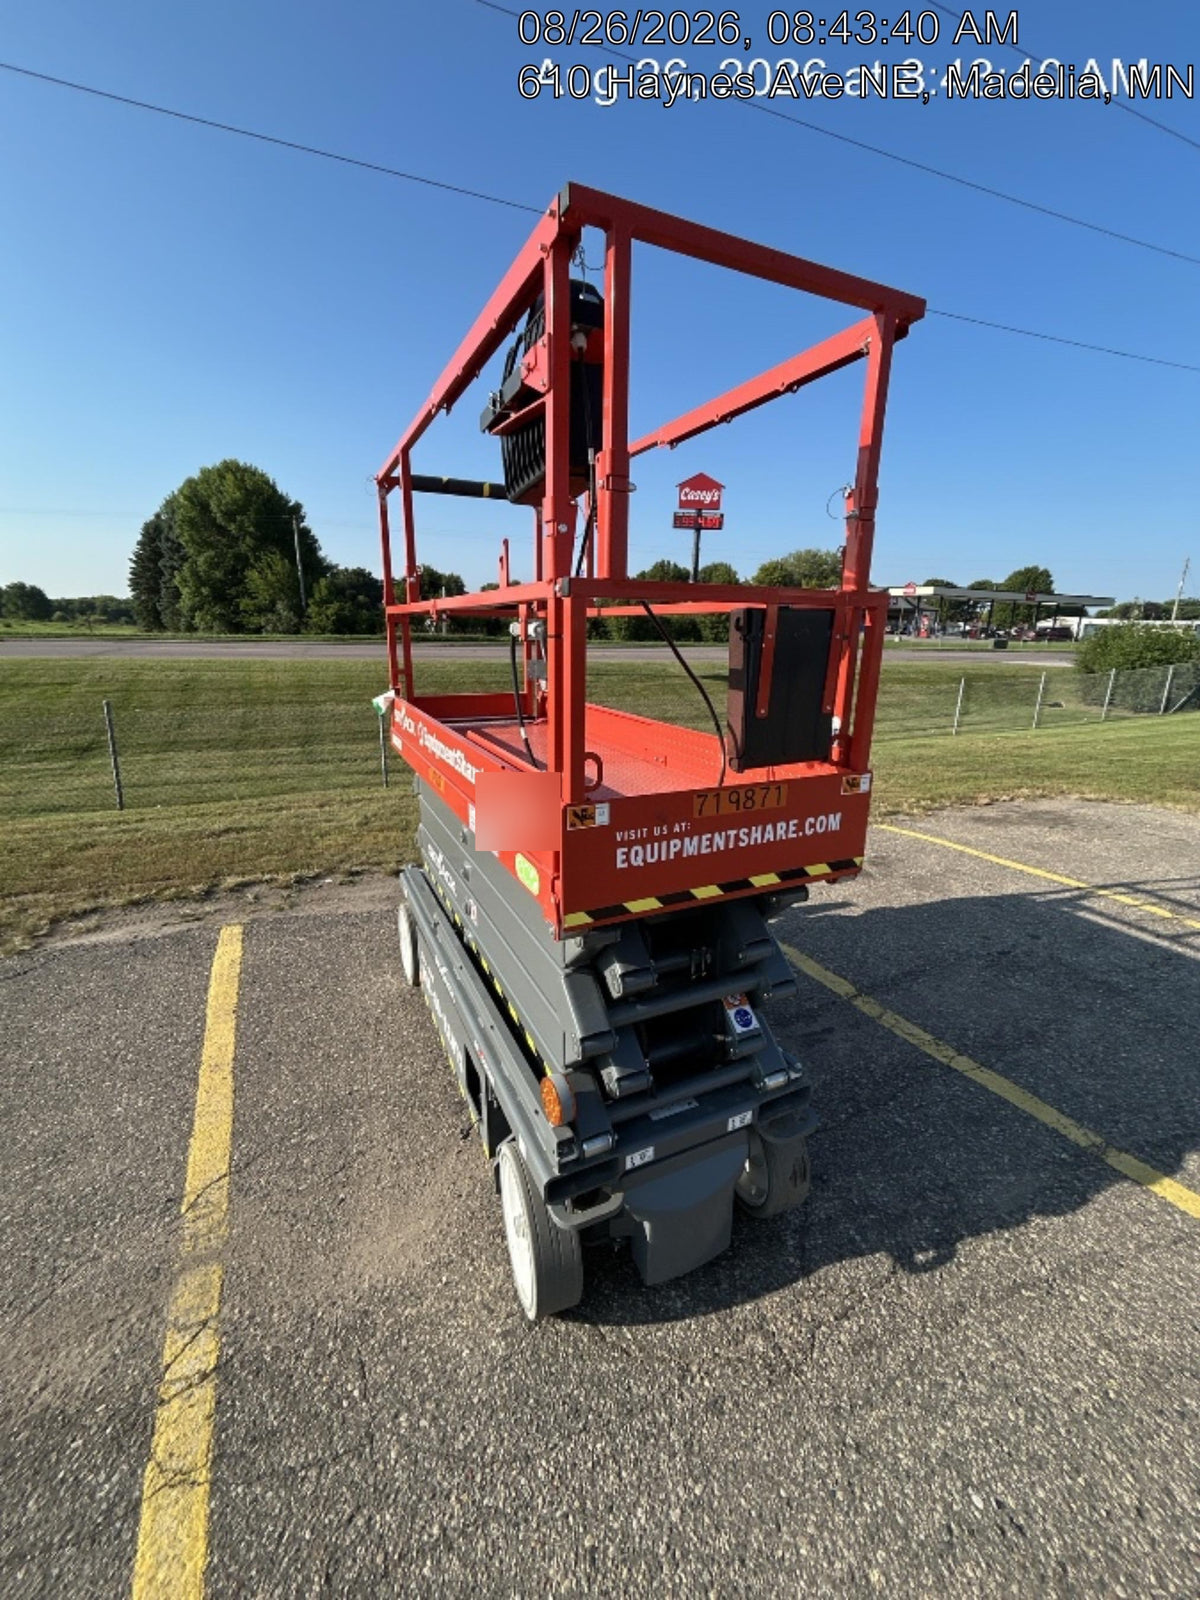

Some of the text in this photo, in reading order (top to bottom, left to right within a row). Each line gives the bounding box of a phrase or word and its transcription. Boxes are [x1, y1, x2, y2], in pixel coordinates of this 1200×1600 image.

[680, 487, 719, 504] Casey's
[696, 785, 783, 816] 719871
[615, 821, 691, 842] VISIT US AT:
[615, 812, 842, 869] EQUIPMENTSHARE.COM
